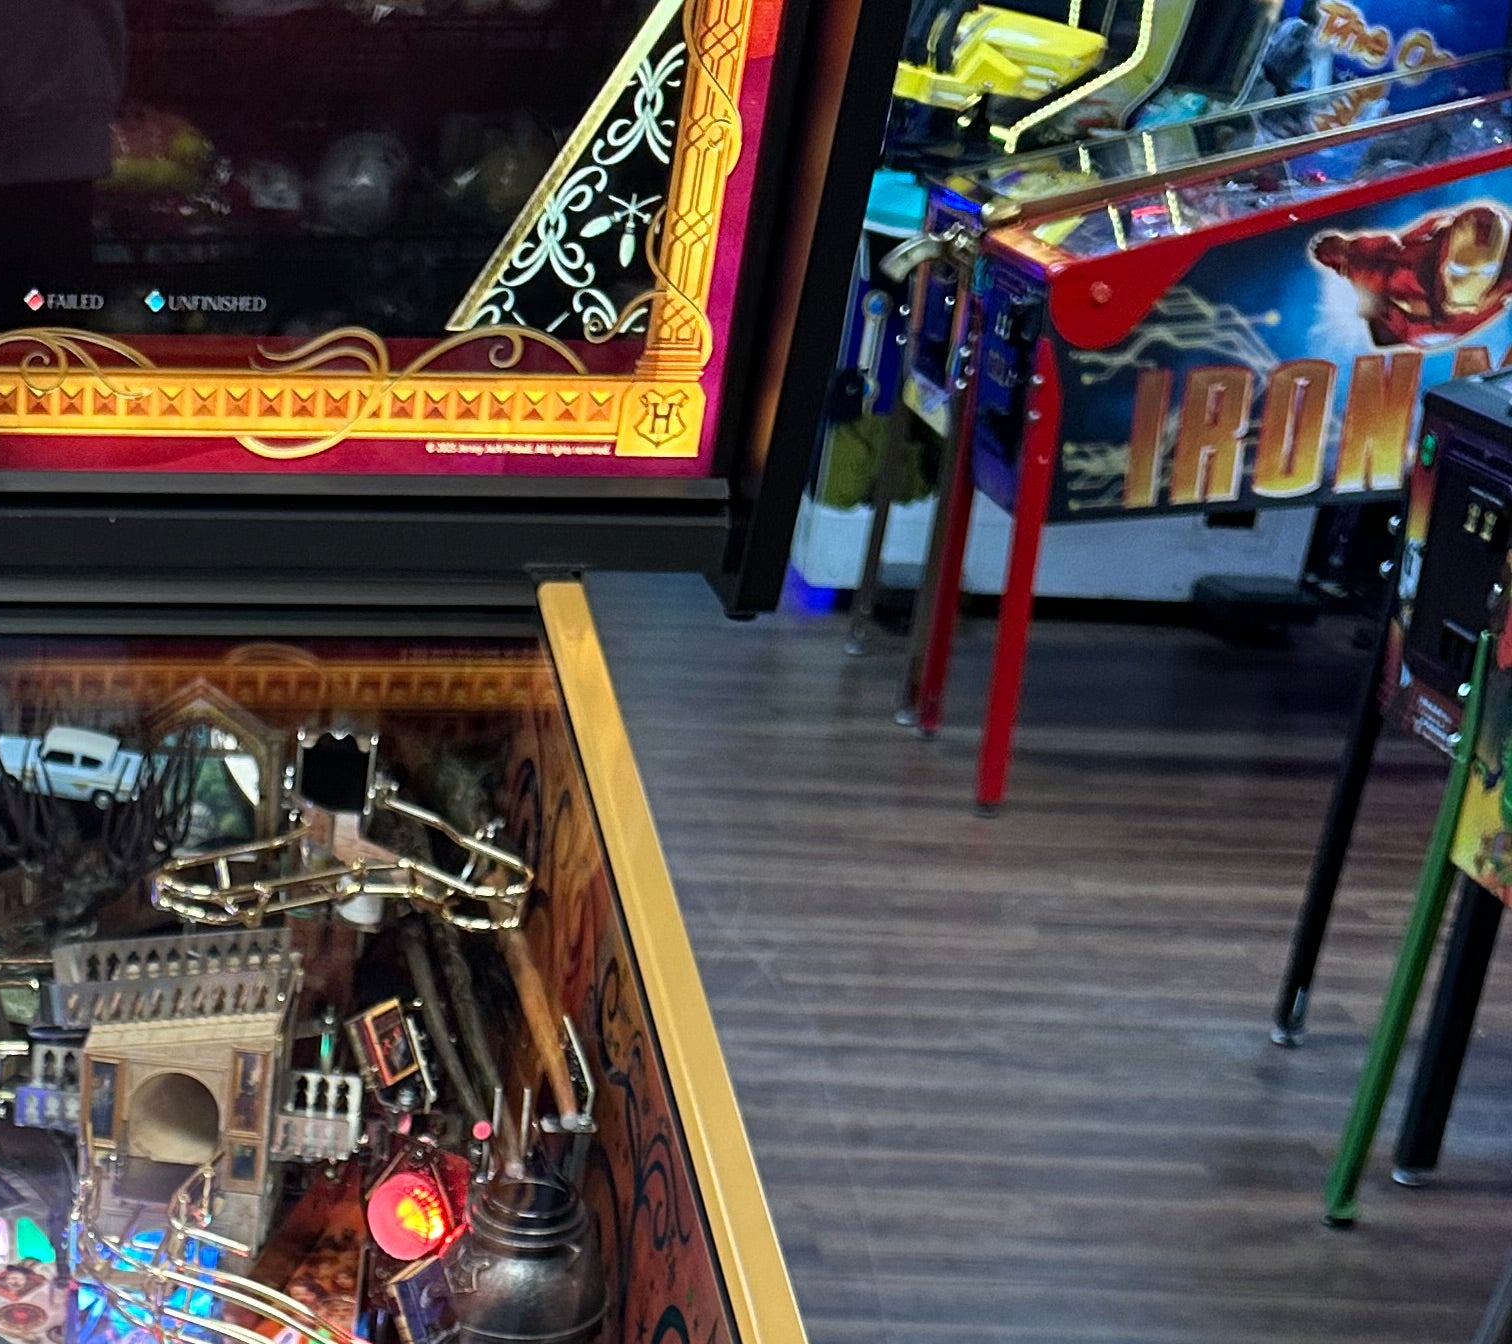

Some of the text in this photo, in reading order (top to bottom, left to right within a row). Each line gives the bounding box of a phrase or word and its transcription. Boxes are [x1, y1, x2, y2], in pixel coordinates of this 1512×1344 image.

[47, 293, 104, 311] FAILED
[169, 294, 267, 312] UNFINISHED
[649, 403, 676, 434] H
[1121, 351, 1424, 509] IRON
